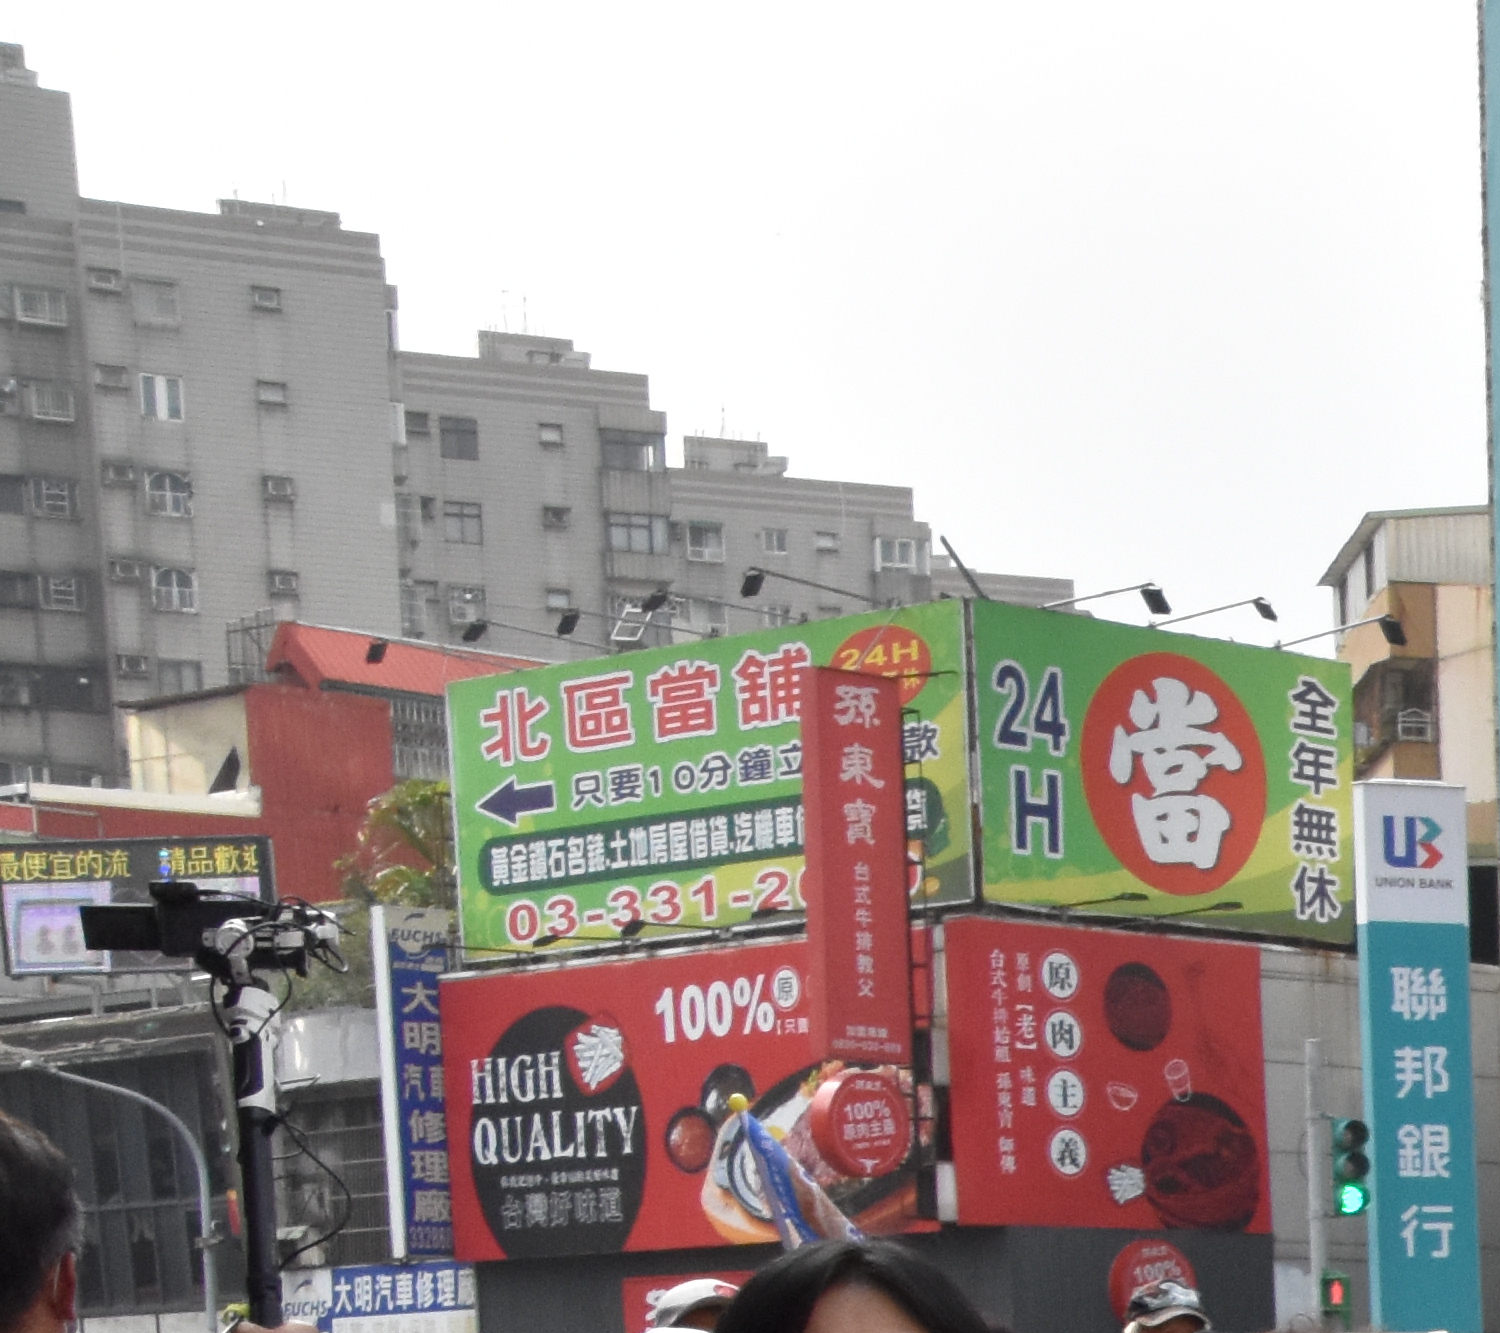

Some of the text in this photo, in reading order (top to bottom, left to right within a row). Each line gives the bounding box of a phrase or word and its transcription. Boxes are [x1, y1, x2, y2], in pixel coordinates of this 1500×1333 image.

[480, 642, 812, 768] 北區當舖
[572, 741, 804, 810] 只要10分鐘立
[1108, 677, 1244, 869] 當
[1288, 676, 1341, 923] 全年無休
[507, 864, 806, 945] 03-331-2
[1375, 877, 1453, 889] UNION BANK
[655, 974, 775, 1043] 100%
[470, 1051, 564, 1105] HIGH
[1050, 959, 1080, 1169] 原肉主義
[473, 1106, 639, 1165] QUALITY
[844, 1100, 891, 1121] 100%
[1391, 966, 1453, 1258] 聯邦銀行
[285, 1299, 327, 1316] FUCHS
[334, 1267, 474, 1313] 大明汽車修理廠
